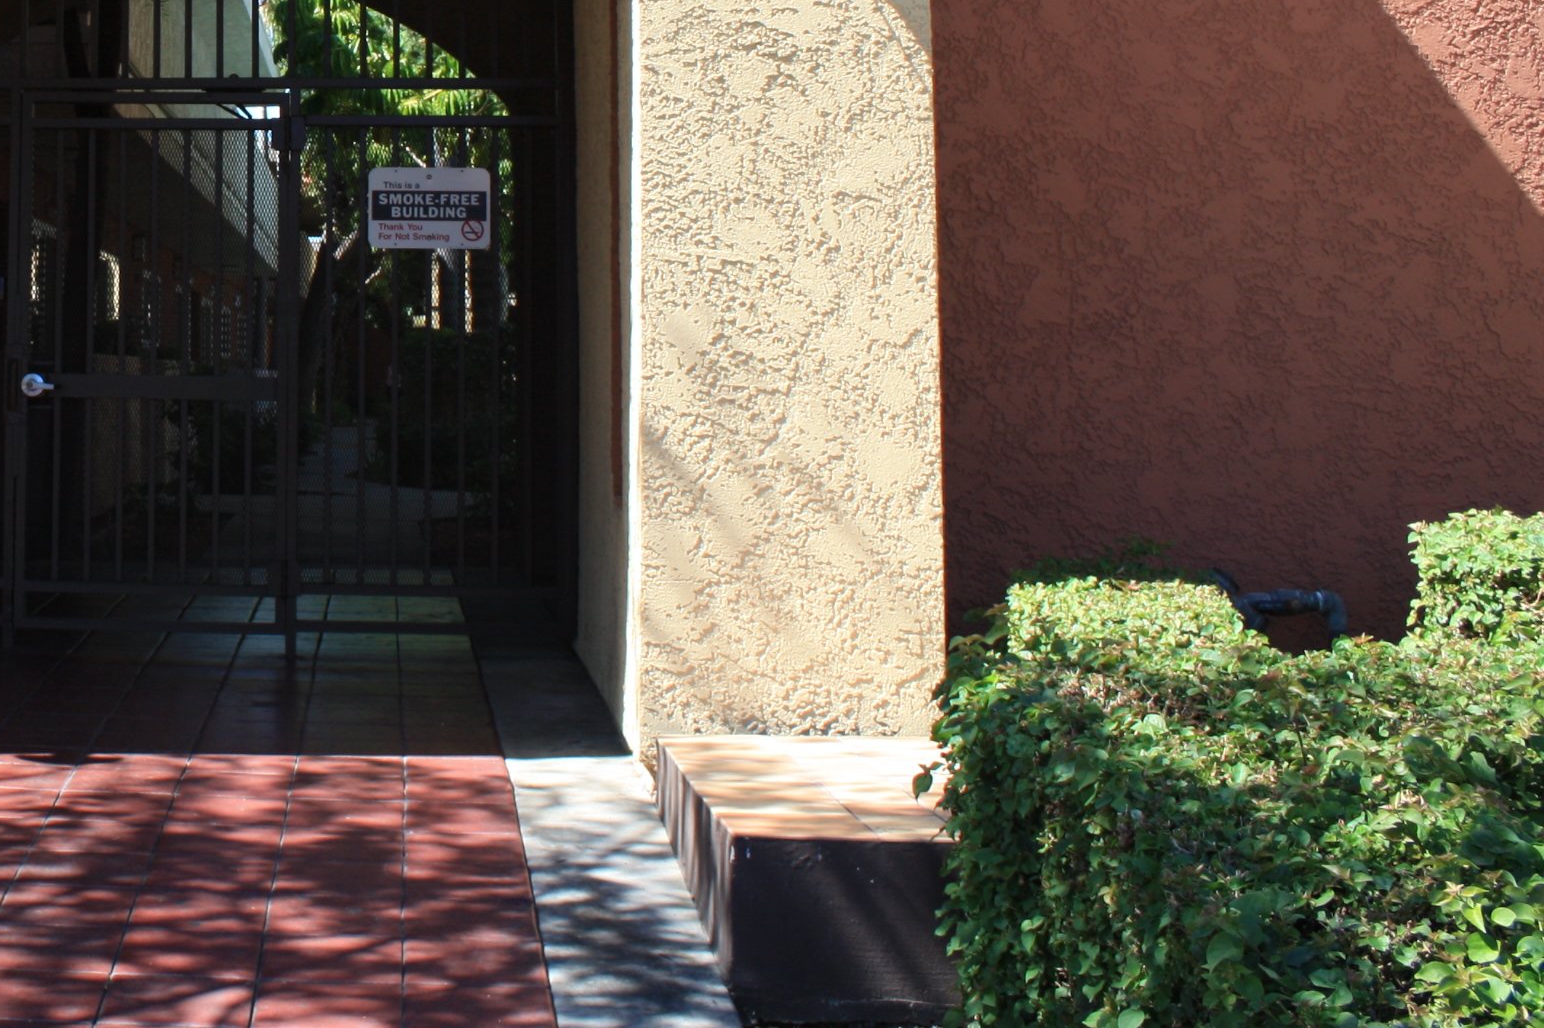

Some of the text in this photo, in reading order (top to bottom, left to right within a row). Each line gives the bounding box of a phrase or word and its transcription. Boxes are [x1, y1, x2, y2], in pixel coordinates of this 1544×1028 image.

[384, 181, 402, 189] This
[405, 181, 413, 189] is
[379, 193, 480, 205] SMOKE-FREE
[391, 207, 467, 218] BUILDING
[378, 222, 423, 231] Thank You
[378, 232, 450, 242] For Not Smoking
